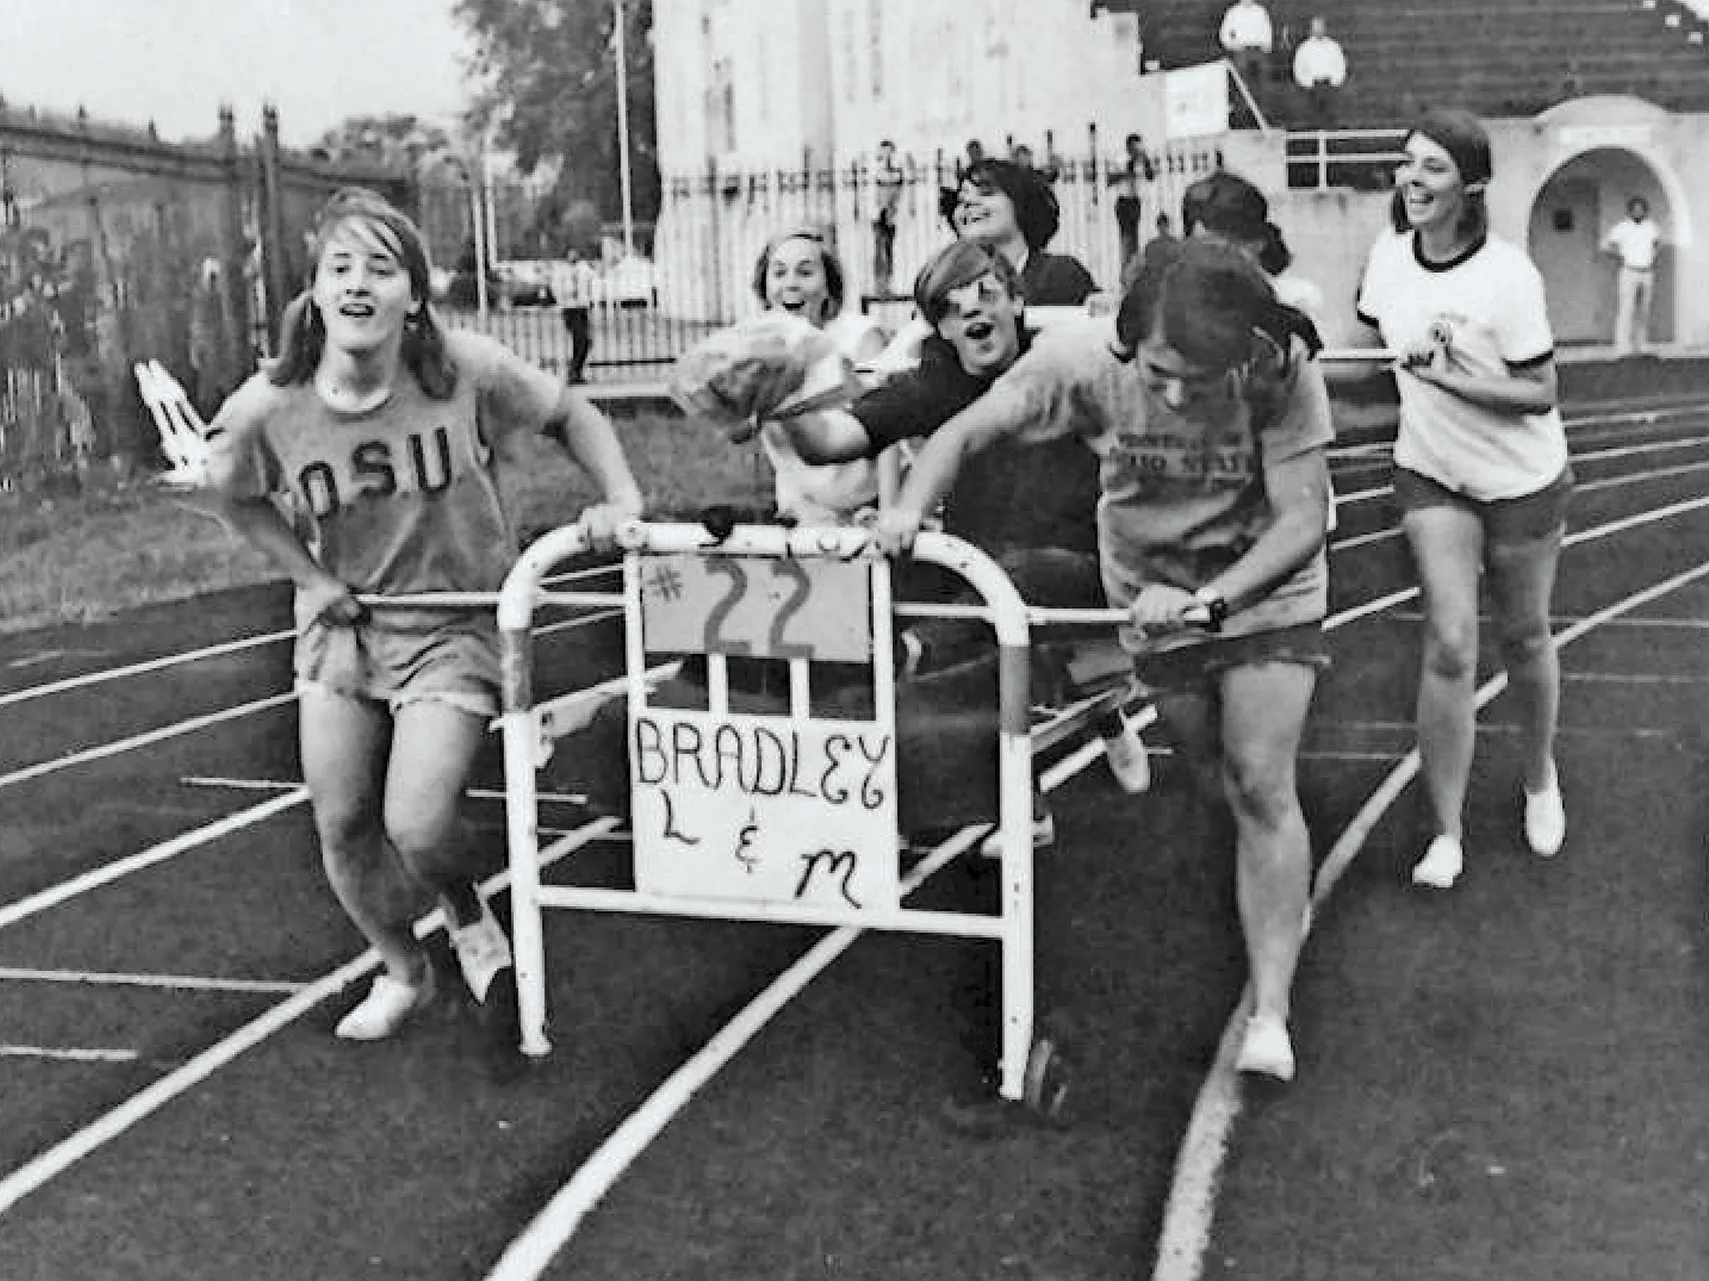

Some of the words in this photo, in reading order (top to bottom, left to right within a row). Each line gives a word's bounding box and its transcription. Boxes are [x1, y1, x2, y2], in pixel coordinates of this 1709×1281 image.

[299, 425, 453, 521] OSU
[636, 717, 891, 810] BRADLEY
[660, 788, 701, 846] L
[734, 806, 761, 875] &
